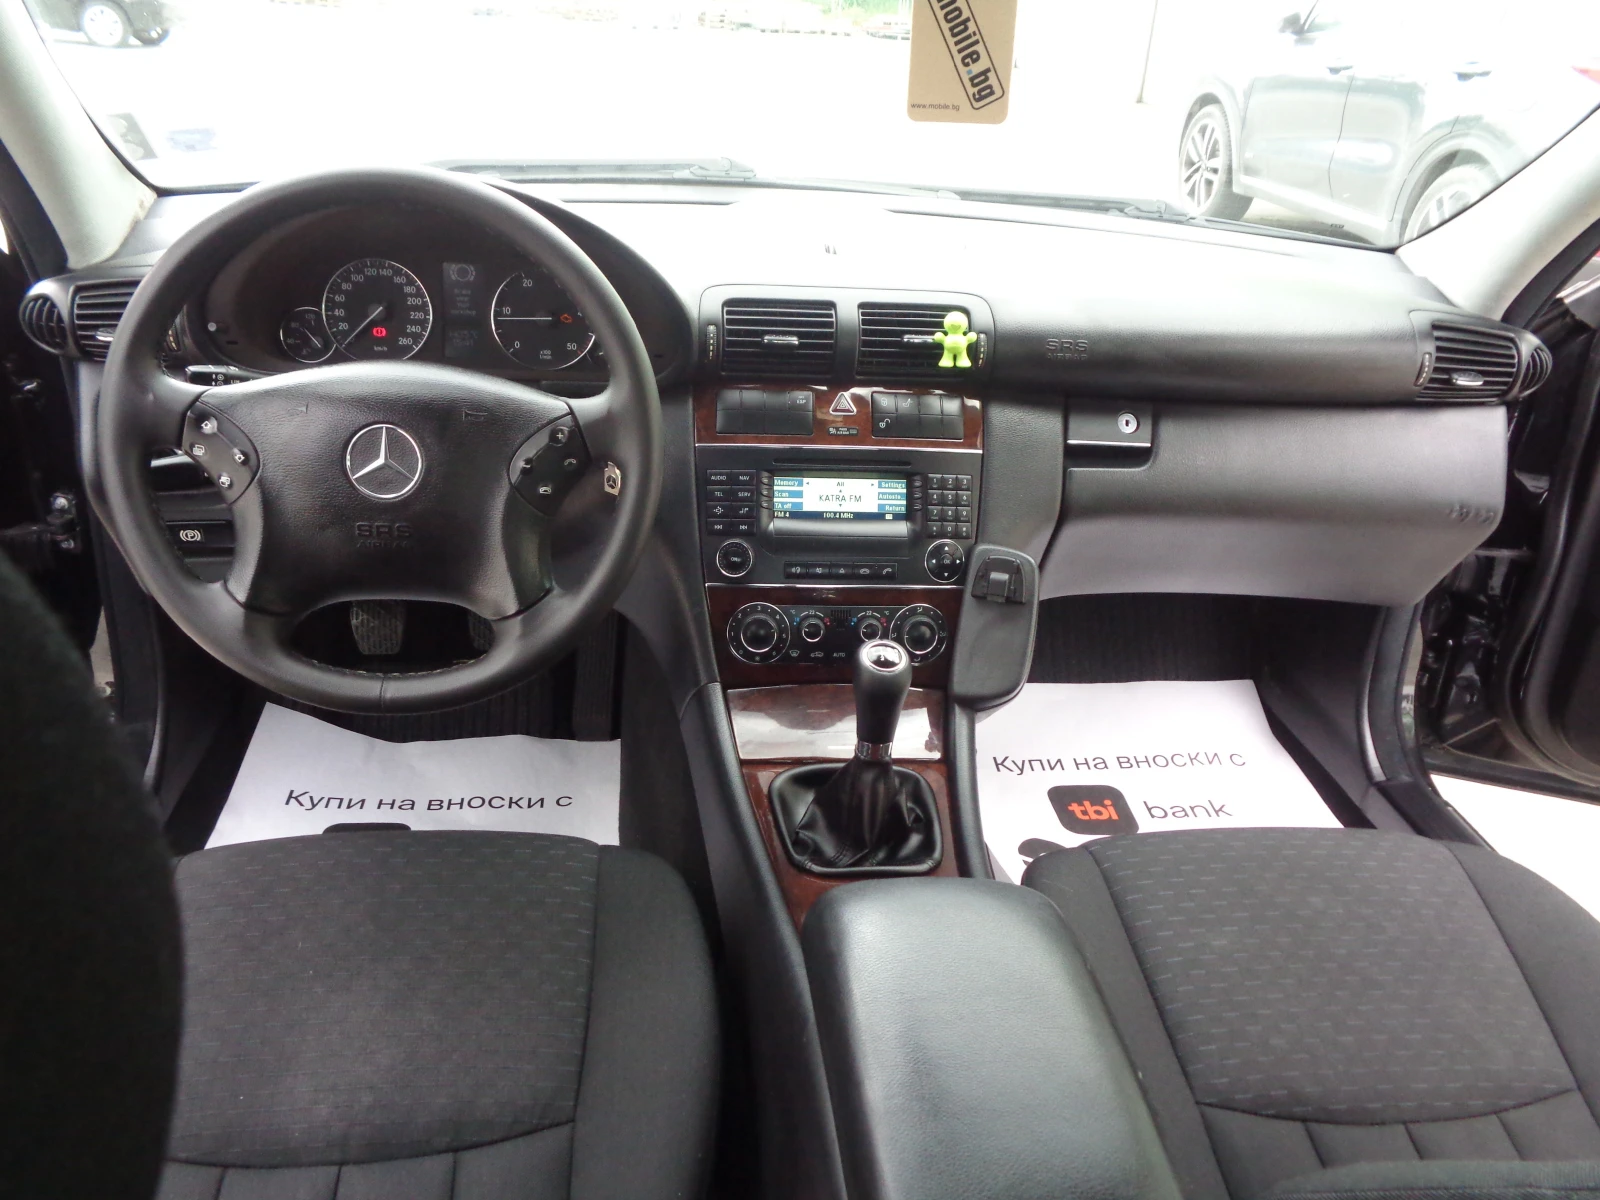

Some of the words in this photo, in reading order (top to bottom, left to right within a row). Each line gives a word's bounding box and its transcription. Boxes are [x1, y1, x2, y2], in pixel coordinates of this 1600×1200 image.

[910, 102, 960, 111] www.mobile.bg
[379, 268, 393, 276] 140
[341, 282, 352, 290] 80
[522, 279, 533, 287] 20
[407, 297, 422, 305] 200
[338, 322, 349, 330] 20
[398, 337, 413, 345] 260
[1046, 338, 1089, 351] SRS
[774, 478, 799, 487] Memory
[881, 481, 906, 489] Settings
[819, 494, 847, 503] KATRA
[849, 495, 862, 503] FM
[356, 521, 412, 537] SRS
[993, 755, 1065, 776] Купи
[1074, 756, 1109, 771] на
[1116, 752, 1223, 770] вноски
[1229, 753, 1246, 767] с
[284, 789, 367, 812] Купи
[376, 798, 416, 811] на
[426, 795, 545, 812] вноски
[555, 795, 574, 808] с
[1067, 799, 1119, 821] tbi
[1143, 800, 1234, 820] bank
